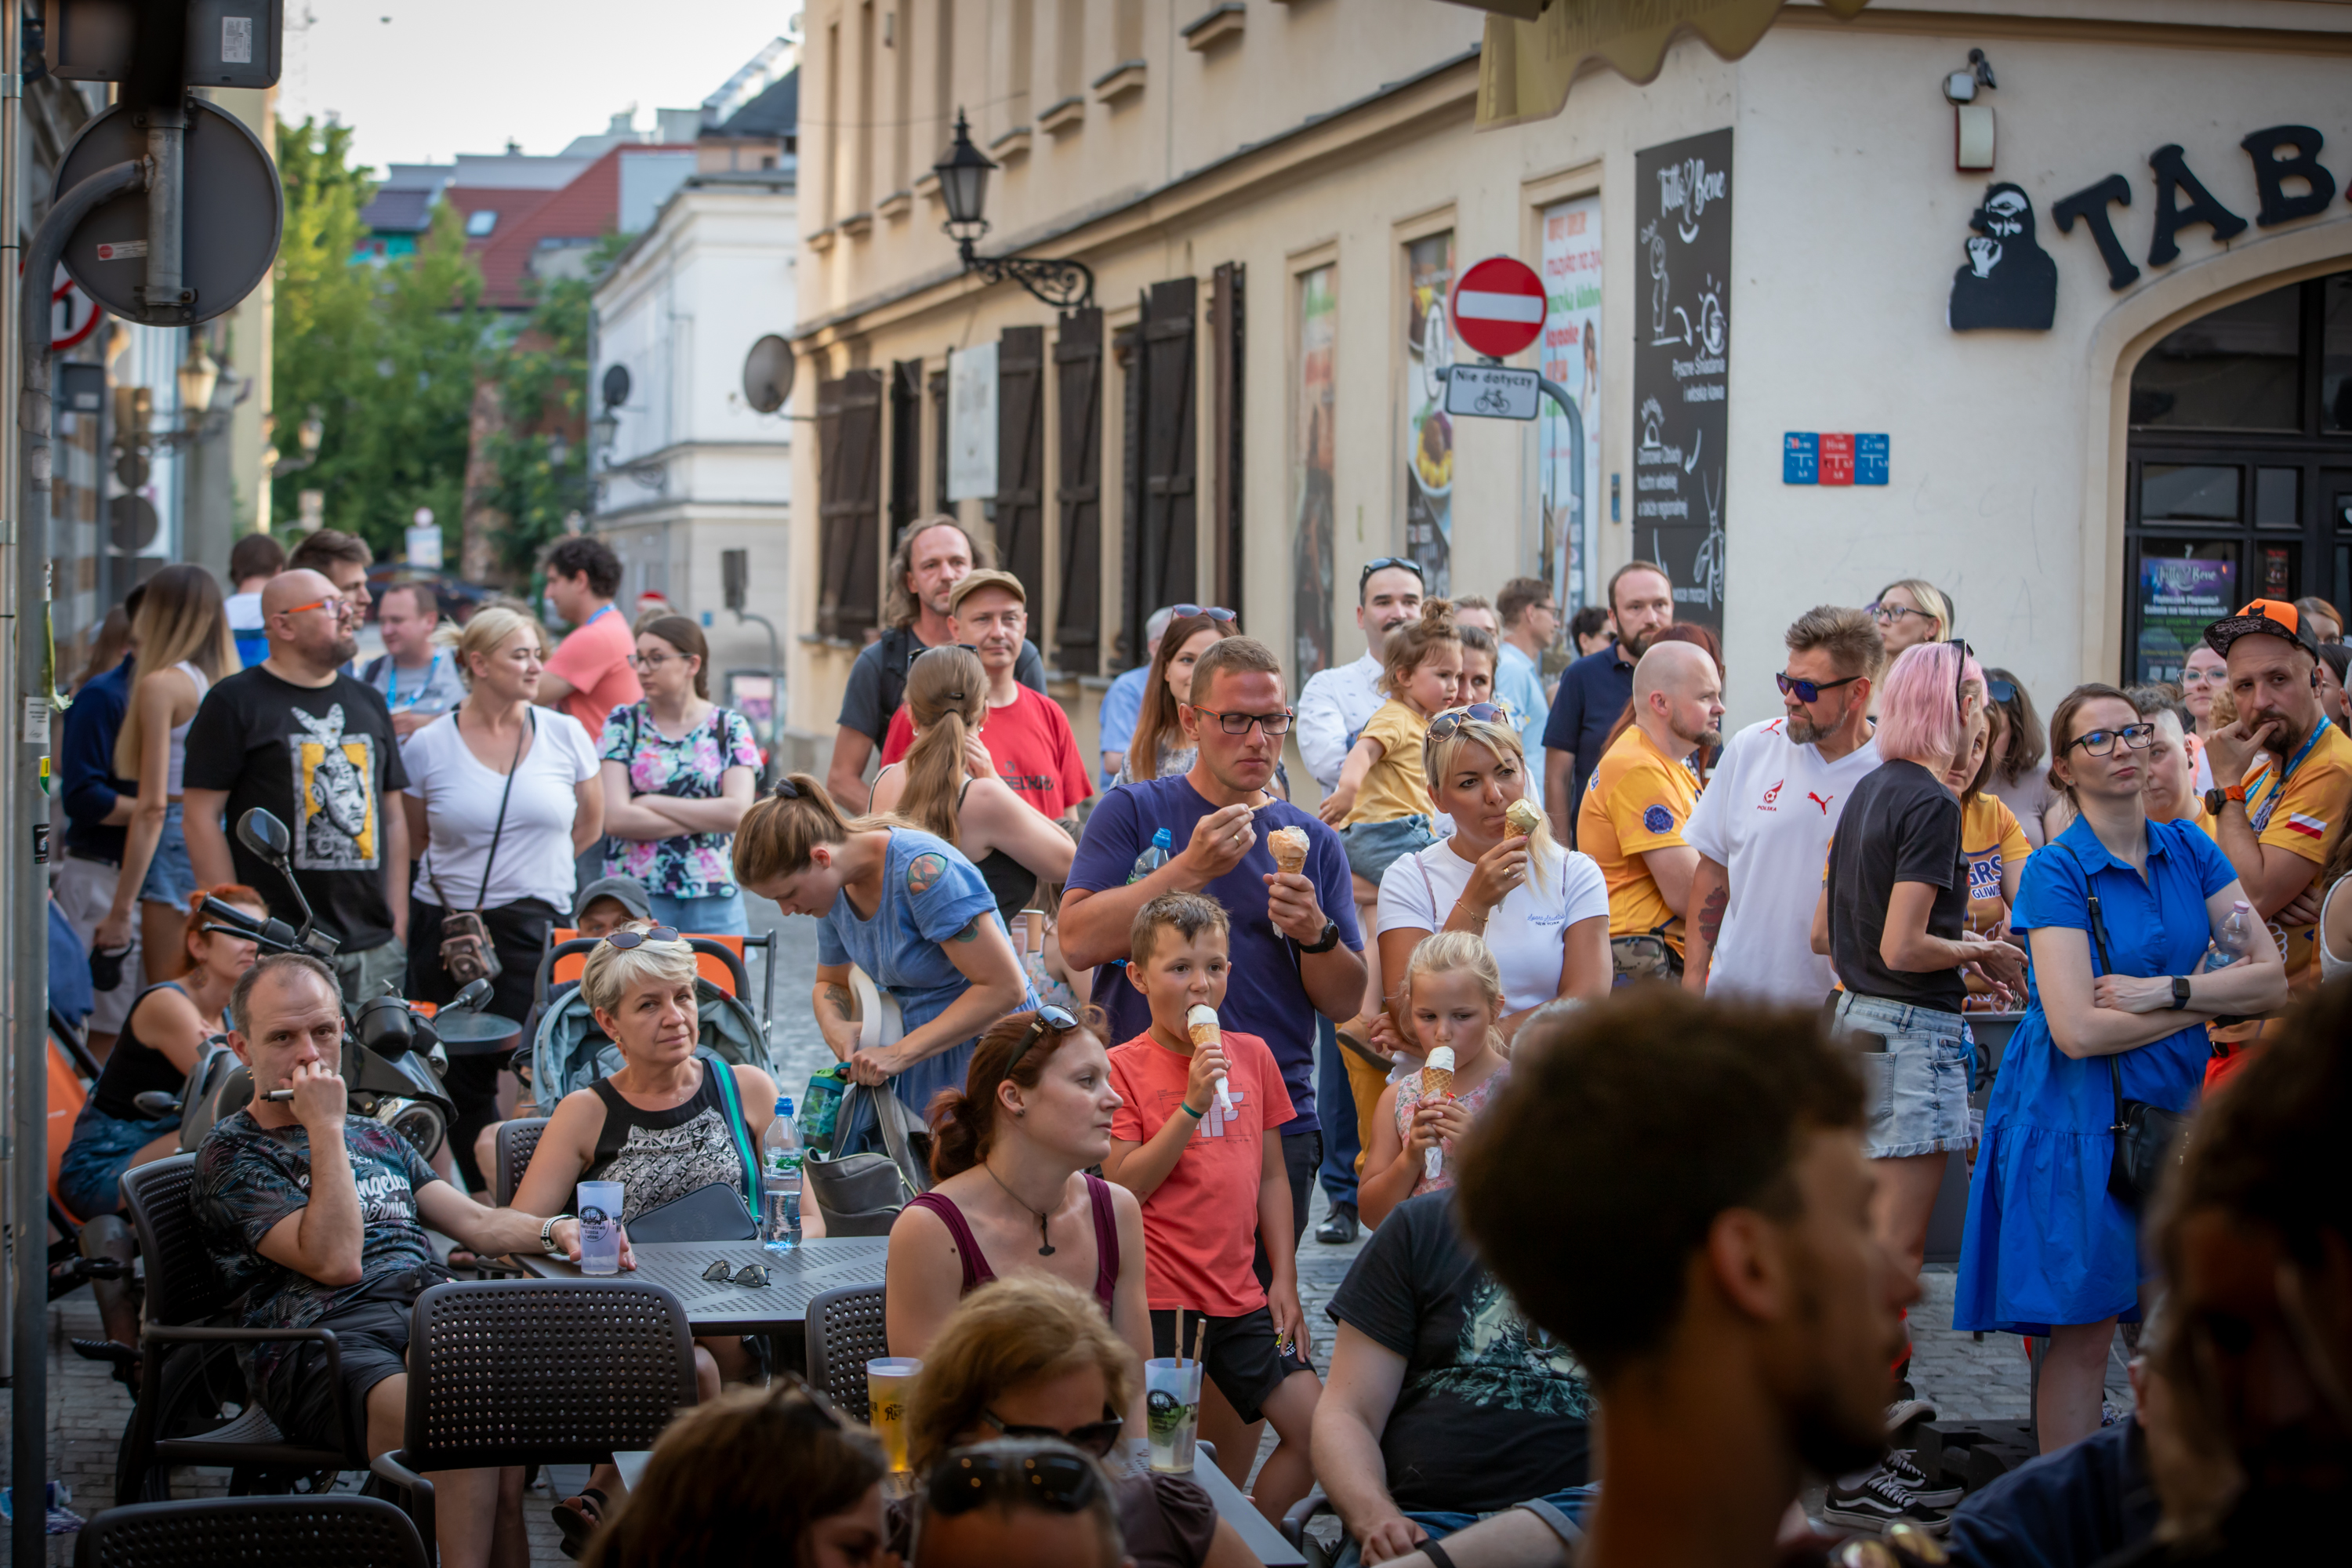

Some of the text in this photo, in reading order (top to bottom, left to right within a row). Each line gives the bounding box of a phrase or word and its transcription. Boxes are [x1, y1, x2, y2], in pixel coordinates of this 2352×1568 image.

[1694, 158, 1726, 216] Bene
[2052, 123, 2352, 292] TAB
[1455, 369, 1534, 389] Nie dotyczy
[2191, 566, 2216, 584] Bene
[347, 1151, 373, 1165] EACH
